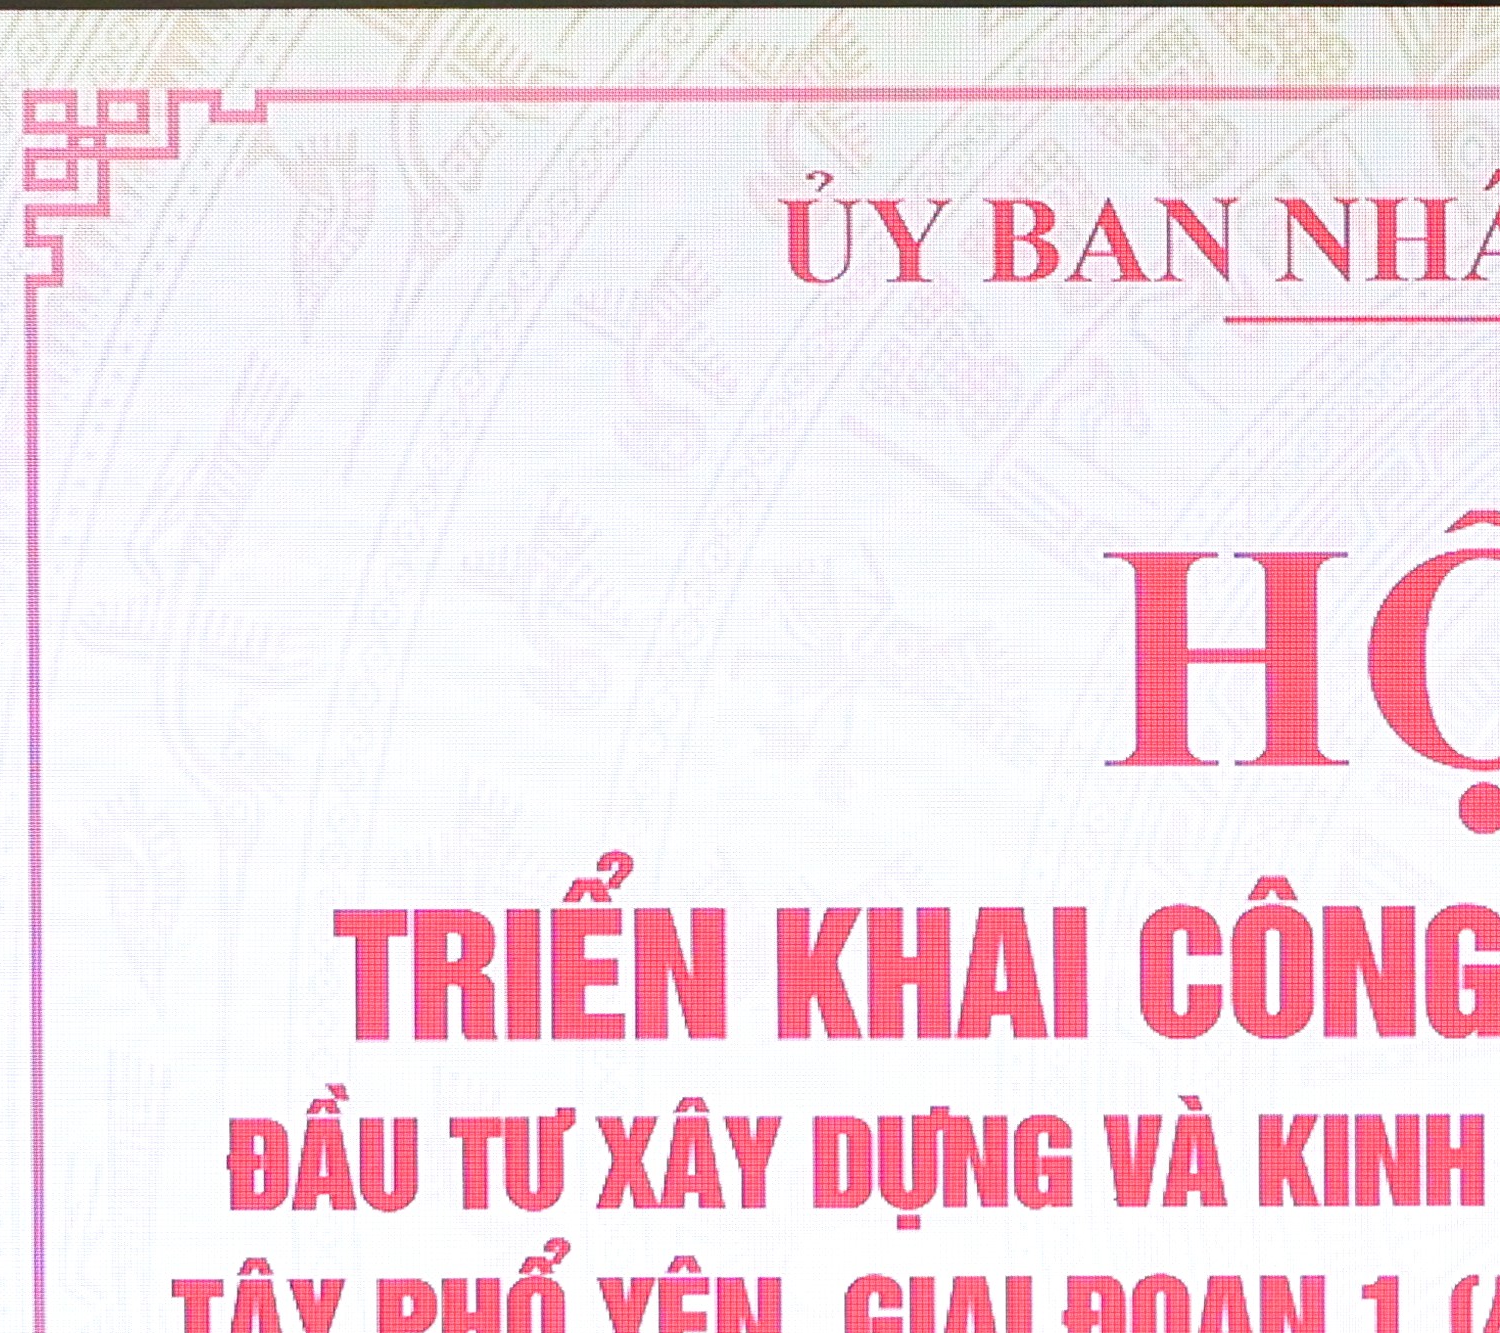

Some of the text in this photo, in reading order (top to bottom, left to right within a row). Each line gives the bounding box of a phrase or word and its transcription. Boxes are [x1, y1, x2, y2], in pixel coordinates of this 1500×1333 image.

[783, 168, 947, 283] ỦY
[989, 198, 1236, 282] BAN
[334, 850, 726, 1040] TRIỂN
[777, 907, 1088, 1039] KHAI
[227, 1084, 418, 1212] ĐẦU
[450, 1108, 575, 1212] TƯ
[597, 1097, 780, 1209] XÂY
[813, 1106, 1072, 1230] DỰNG
[1105, 1096, 1227, 1207] VÀ
[1259, 1114, 1485, 1207] KINH
